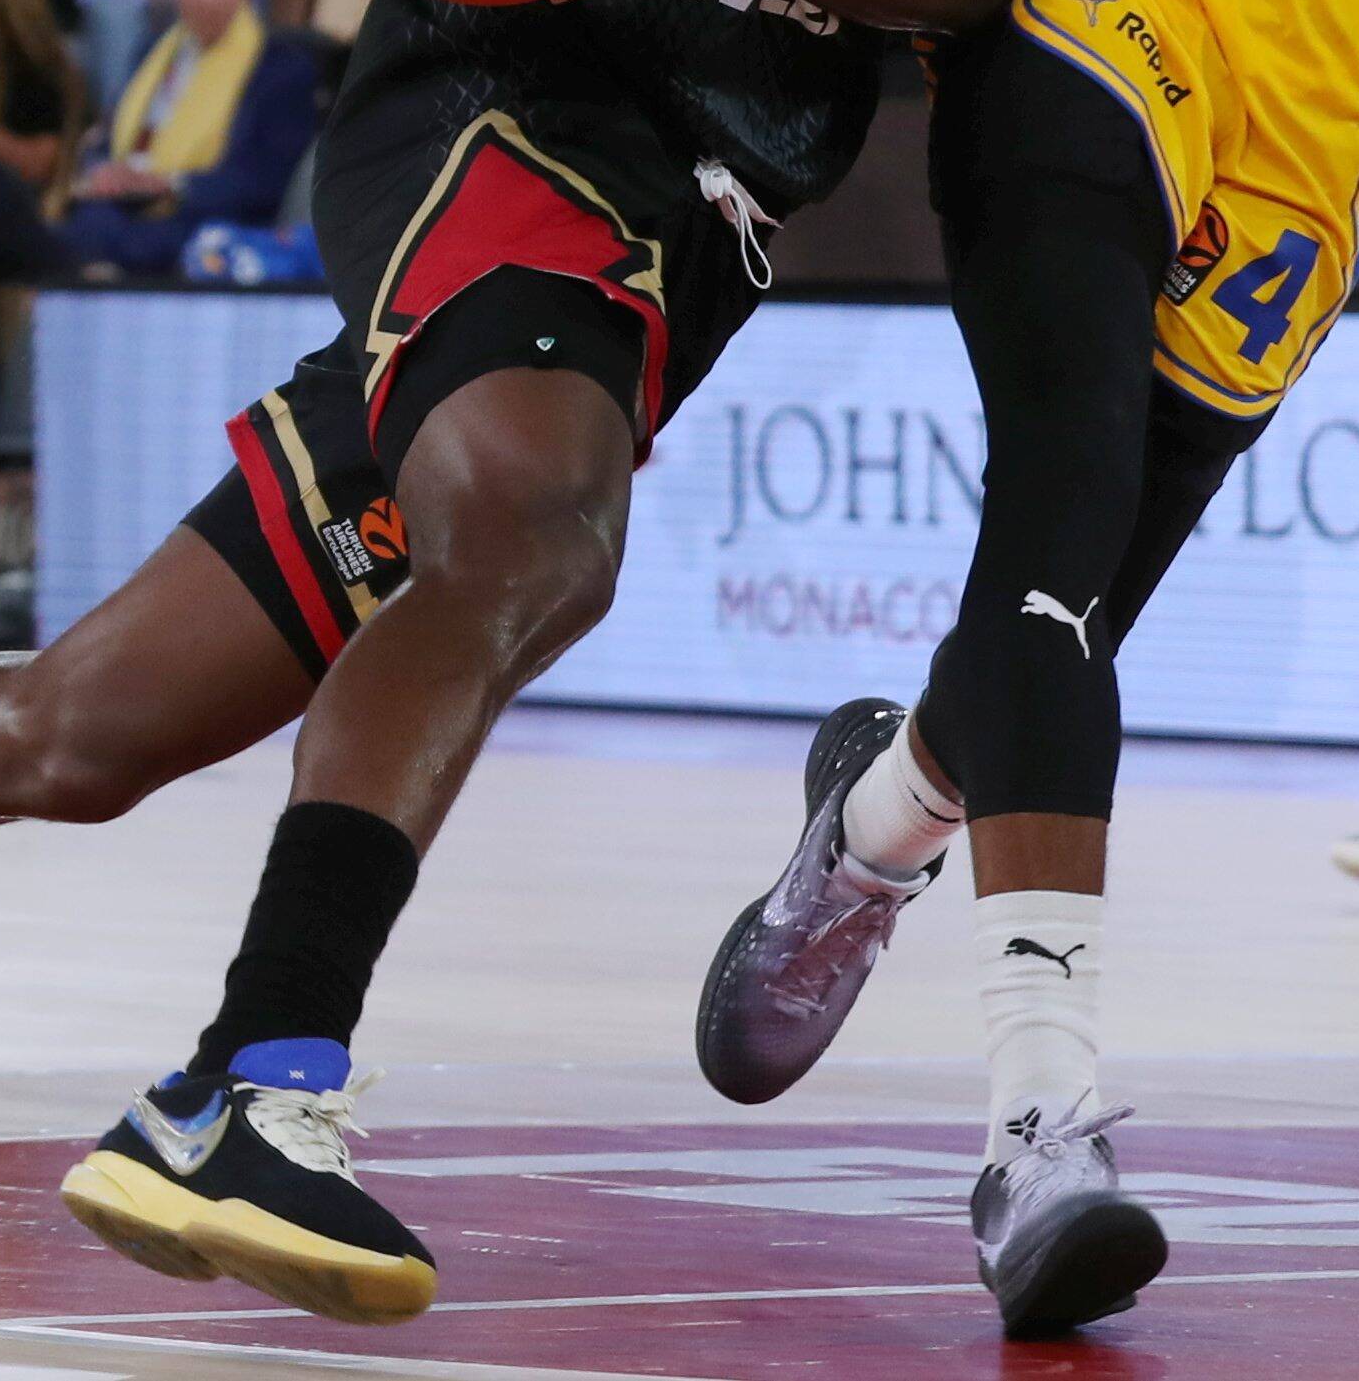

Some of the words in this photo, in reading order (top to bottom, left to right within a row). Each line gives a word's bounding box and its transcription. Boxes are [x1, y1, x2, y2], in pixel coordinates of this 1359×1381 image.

[1211, 229, 1320, 365] 4
[716, 404, 987, 546] JOHN
[331, 524, 364, 577] AIRLINES
[341, 518, 374, 572] TURKISH
[716, 573, 959, 642] MONACO
